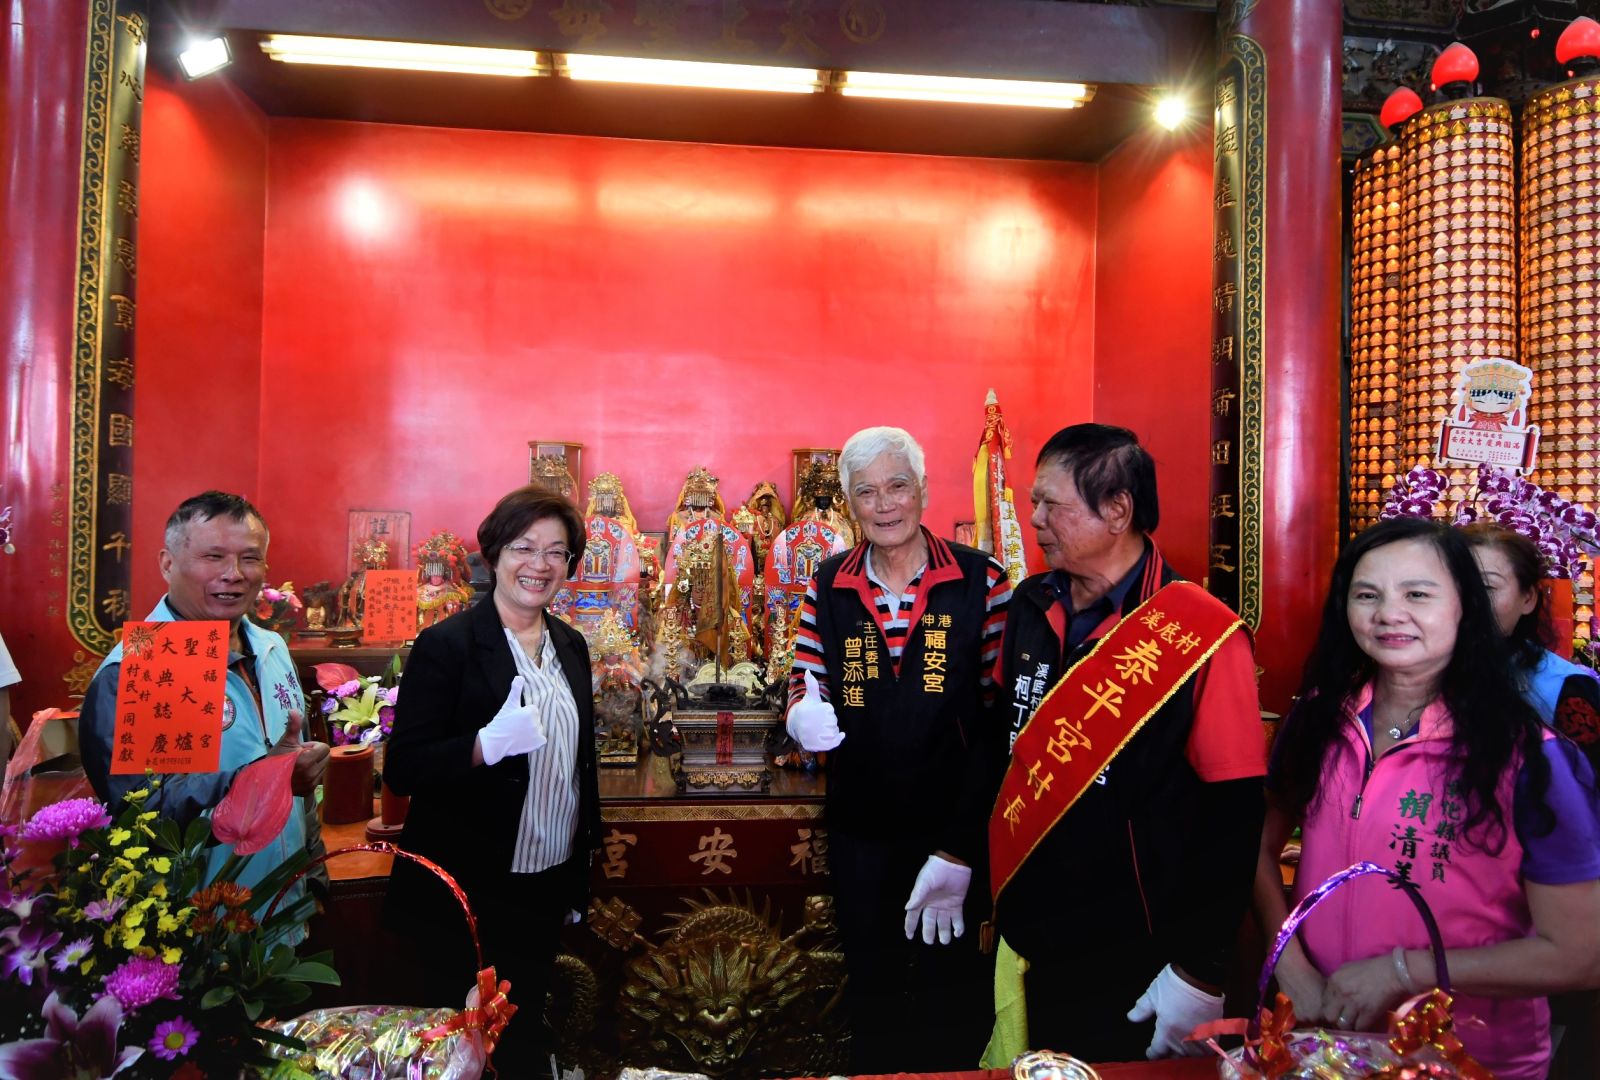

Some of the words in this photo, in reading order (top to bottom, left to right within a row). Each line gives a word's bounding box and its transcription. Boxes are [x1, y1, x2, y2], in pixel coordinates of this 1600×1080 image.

[863, 621, 880, 679] 主任委員
[923, 630, 947, 693] 福安宮
[1139, 608, 1202, 655] 溪底村
[151, 637, 178, 754] 大典誌慶
[843, 637, 865, 707] 曾添進
[118, 663, 141, 763] 村民一同敬獻
[601, 826, 830, 879] 福安宮
